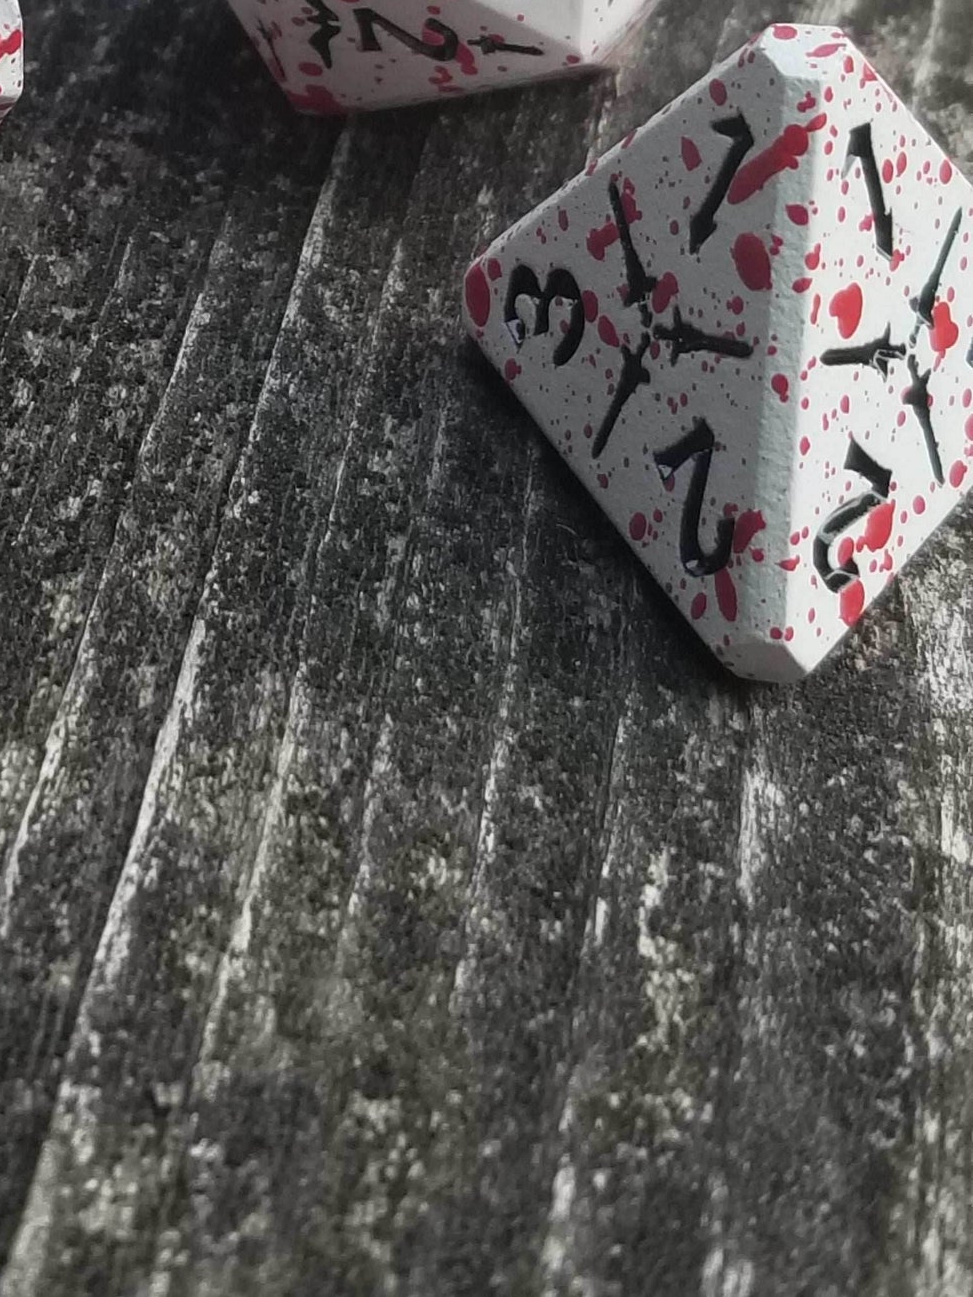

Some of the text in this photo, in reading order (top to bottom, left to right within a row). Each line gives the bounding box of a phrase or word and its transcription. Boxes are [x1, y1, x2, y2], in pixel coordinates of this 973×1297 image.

[840, 122, 896, 262] 1
[503, 264, 586, 367] 3
[653, 417, 736, 578] 2
[812, 437, 893, 594] 2
